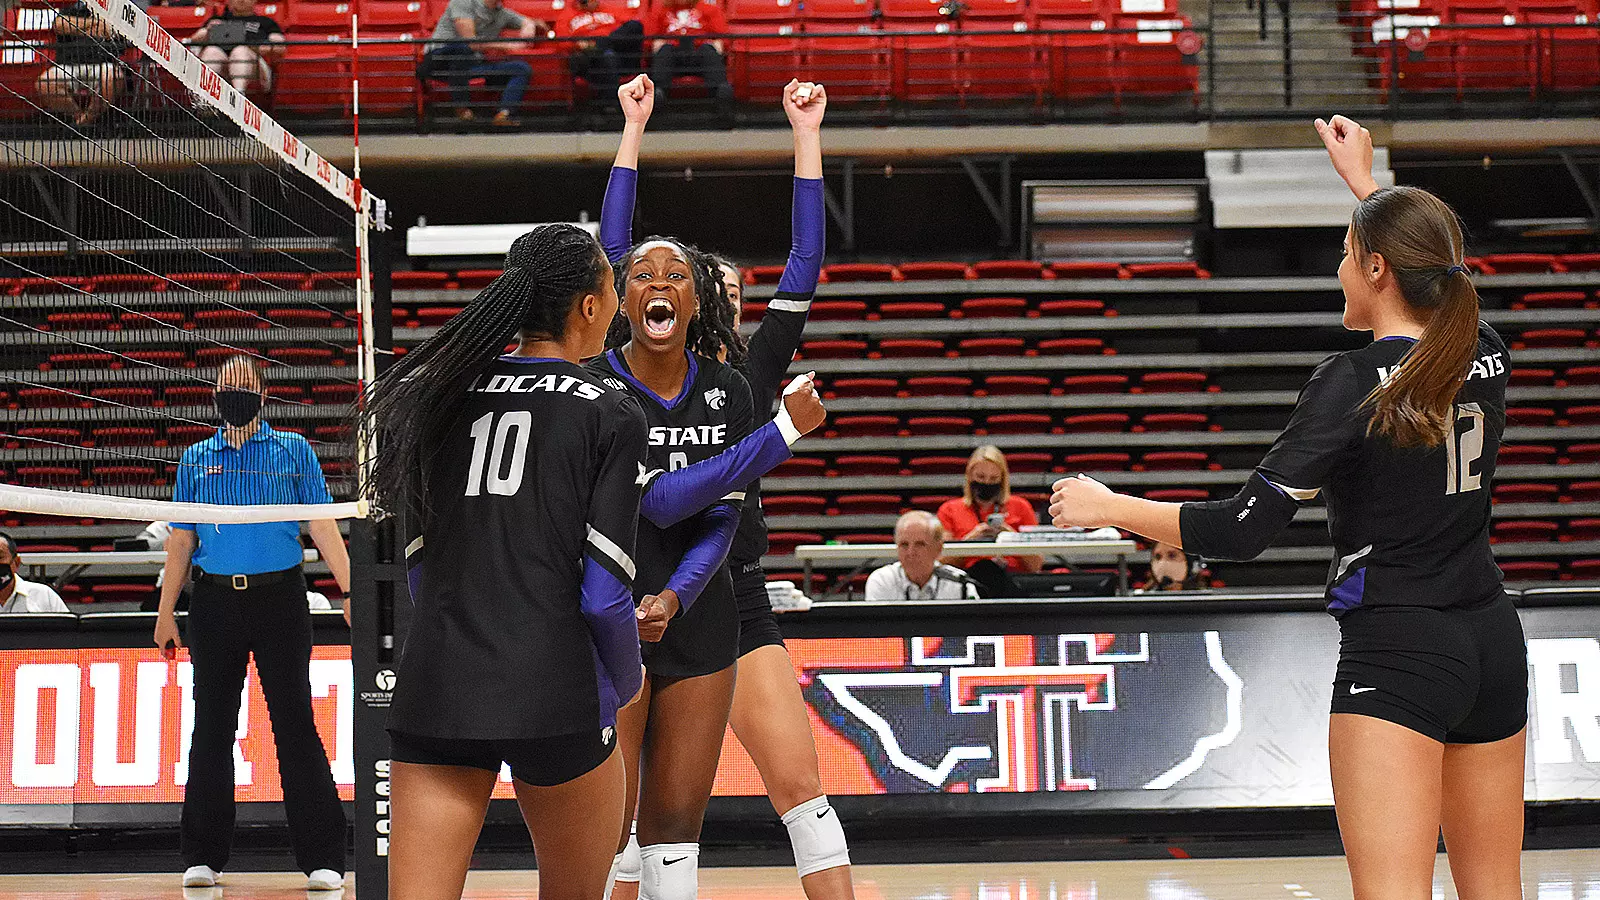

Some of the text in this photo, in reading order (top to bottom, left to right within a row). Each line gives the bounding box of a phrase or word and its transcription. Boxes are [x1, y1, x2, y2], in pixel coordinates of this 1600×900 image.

[464, 411, 532, 496] 10
[648, 424, 727, 446] STATE
[1445, 402, 1485, 495] 12
